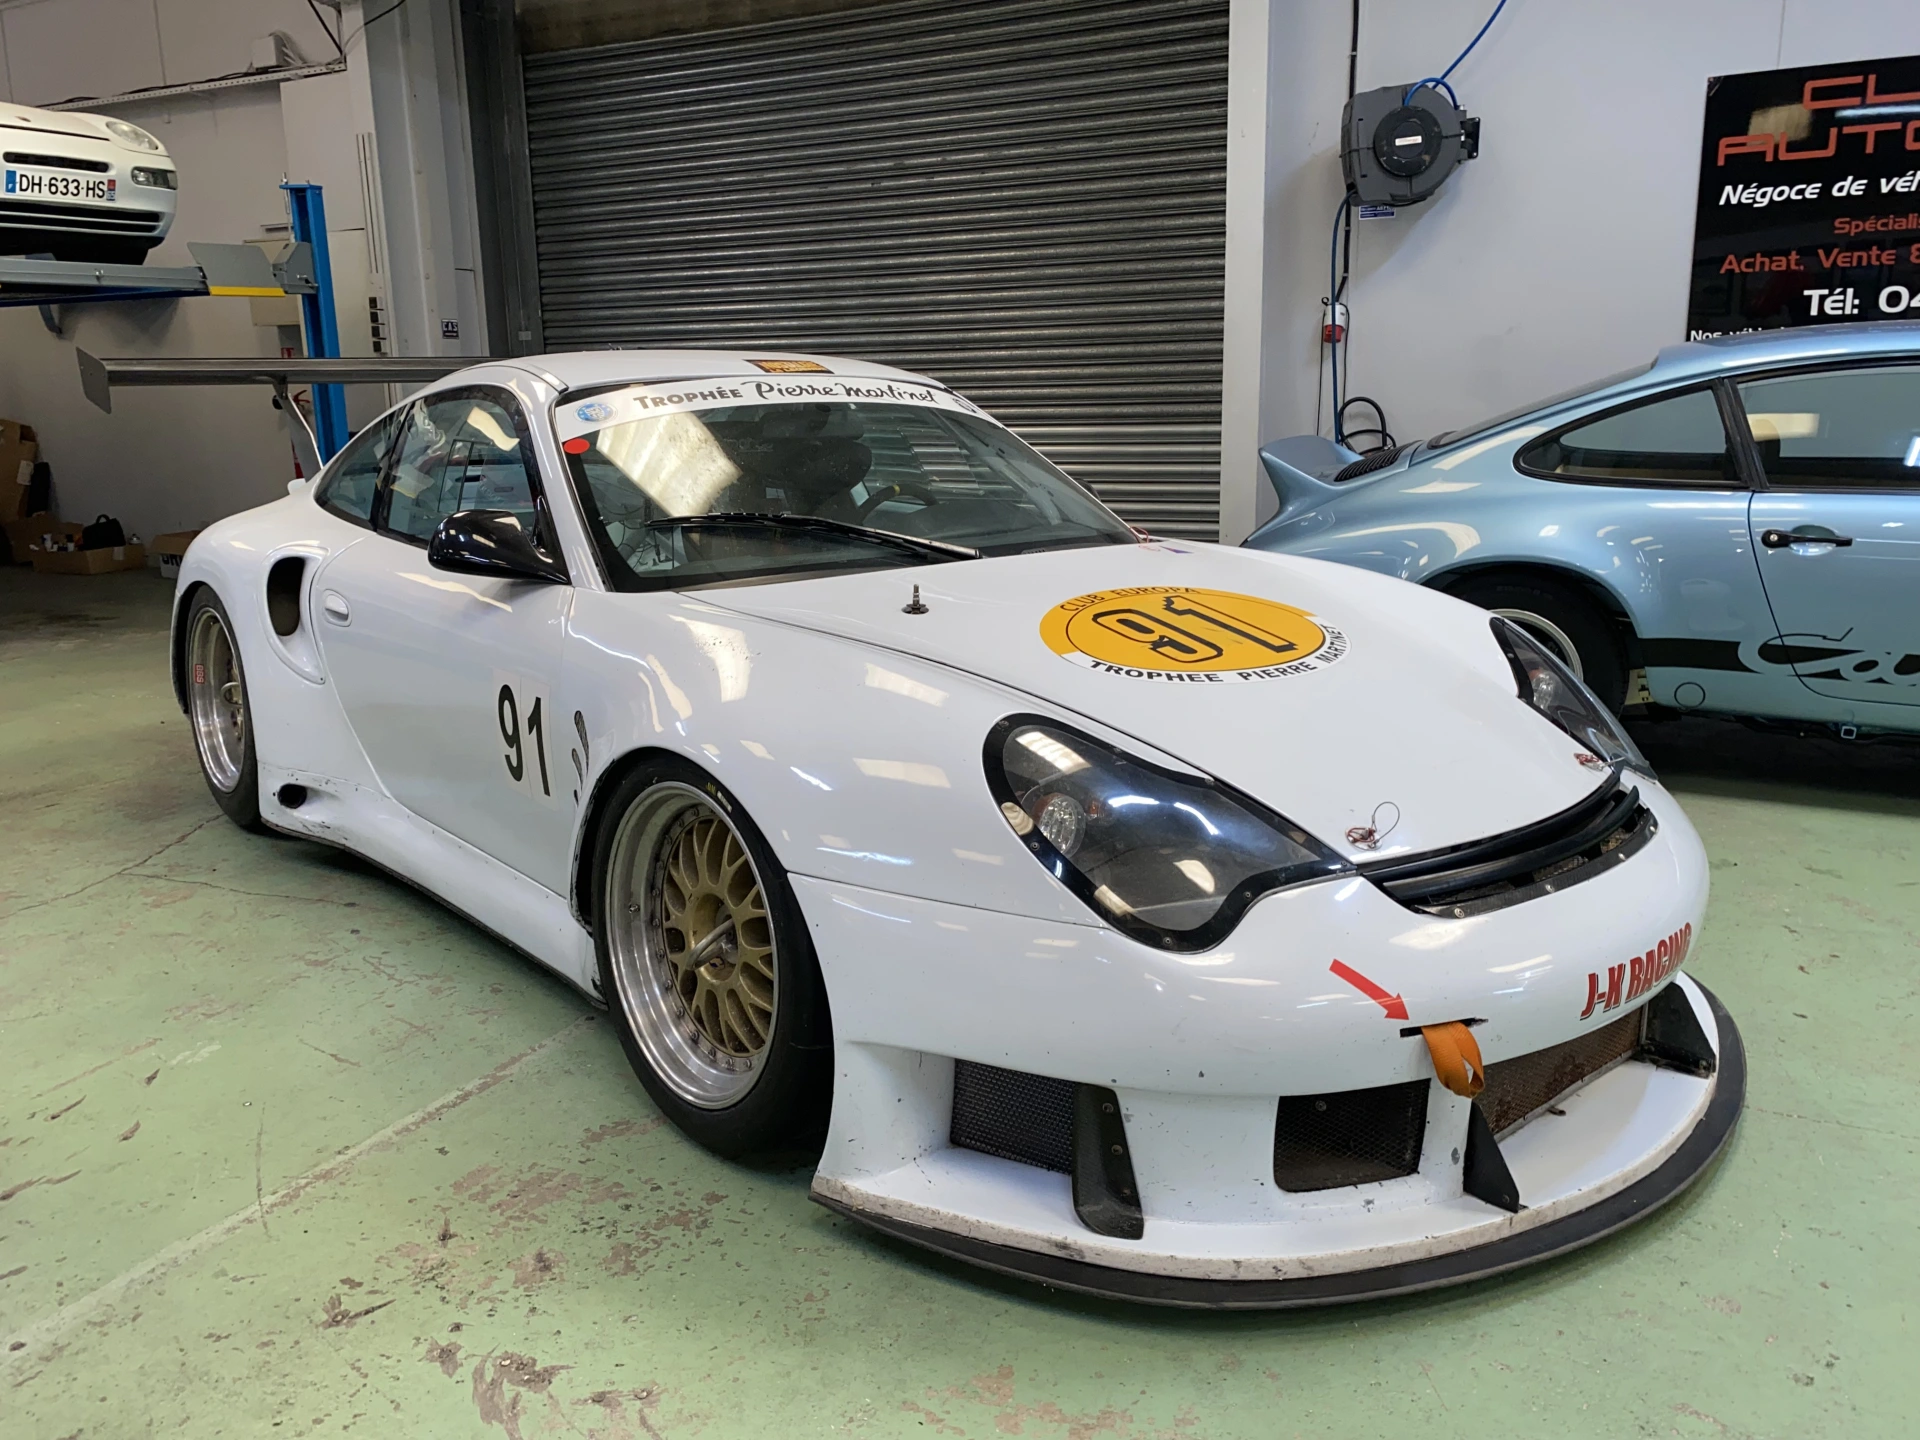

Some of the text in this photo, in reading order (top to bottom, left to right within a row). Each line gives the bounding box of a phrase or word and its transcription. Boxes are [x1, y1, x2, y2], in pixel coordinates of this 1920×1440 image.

[19, 174, 105, 198] DH-633-HS
[1719, 183, 1822, 208] Négoce
[1832, 176, 1868, 197] de
[1817, 246, 1896, 269] Vente
[1803, 287, 1860, 316] Tél:
[740, 381, 839, 400] Pierre
[835, 383, 940, 404] Martinet
[1060, 586, 1199, 611] CLUB EUROPA
[1092, 595, 1299, 663] 91
[1090, 624, 1346, 682] TROPHEE PIERRE MARTINET
[498, 684, 550, 797] 91
[1580, 922, 1692, 1020] J-K RACING
